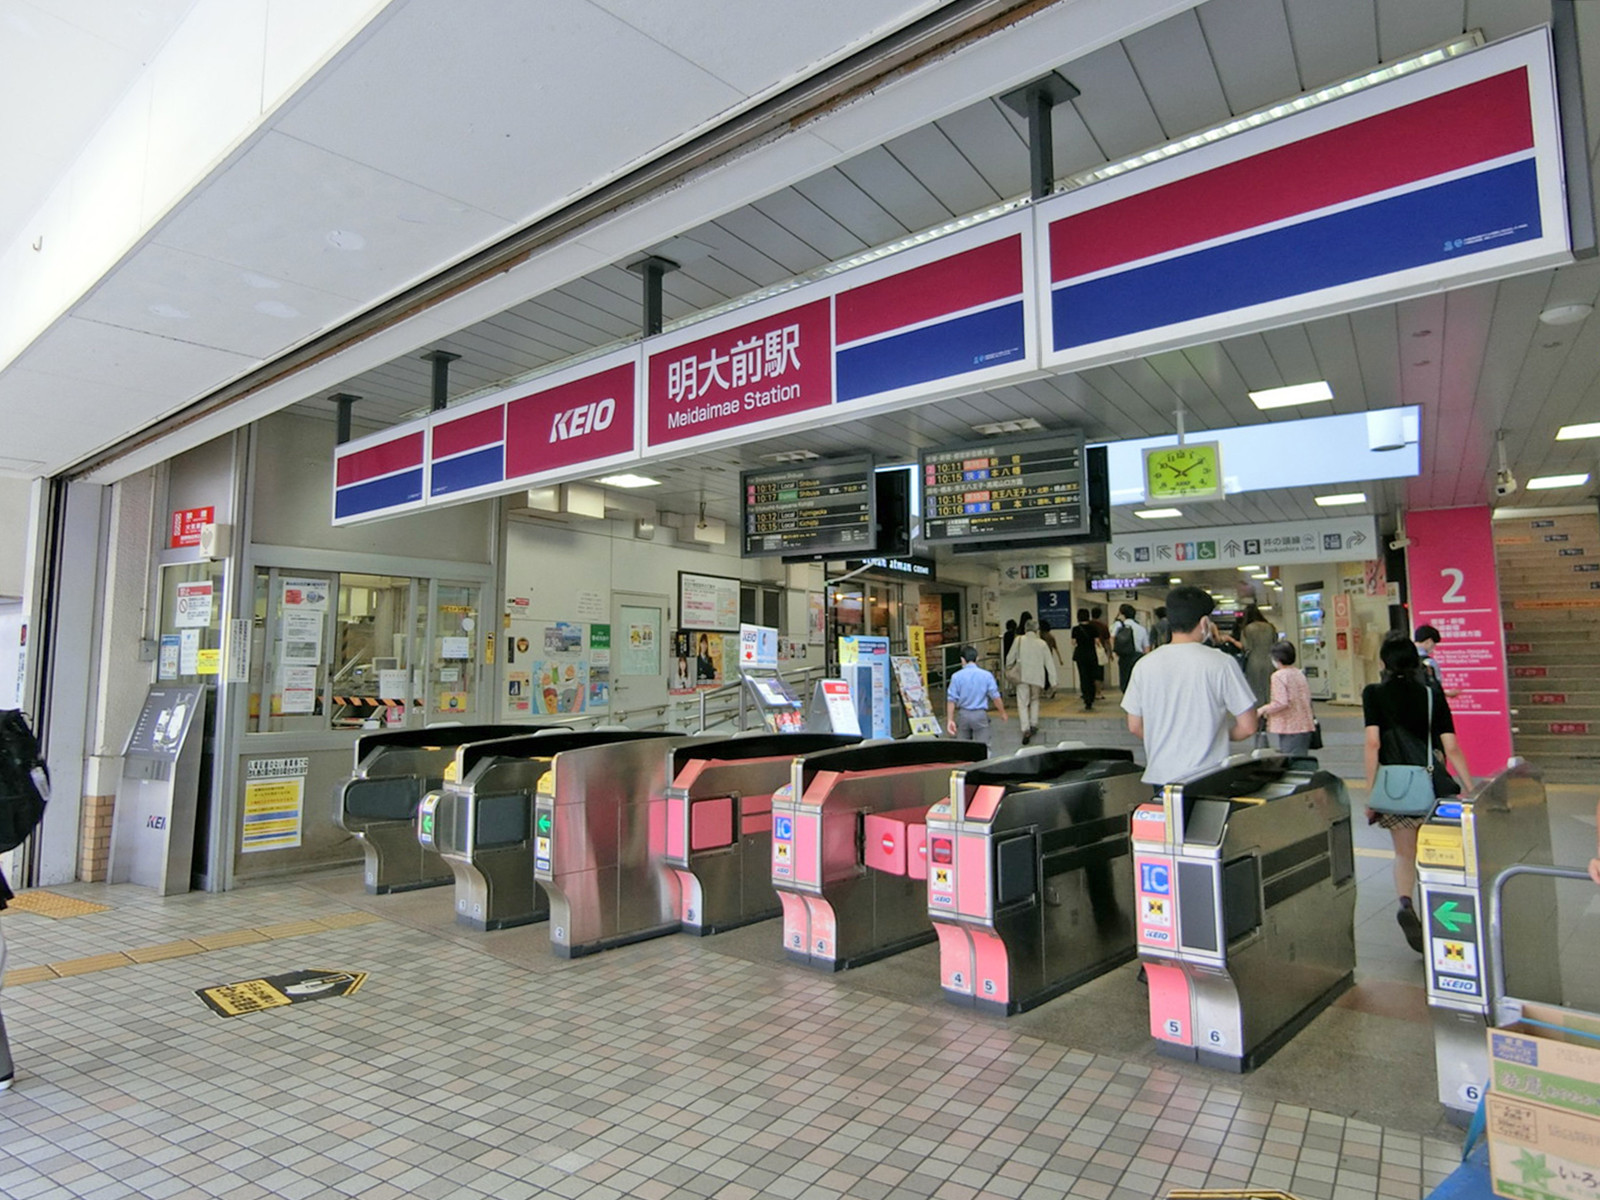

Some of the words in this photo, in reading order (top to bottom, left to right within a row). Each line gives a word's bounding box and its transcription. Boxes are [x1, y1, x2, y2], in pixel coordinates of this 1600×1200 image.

[668, 324, 801, 403] 明大前駅
[668, 401, 740, 429] Meidaimae
[743, 383, 801, 411] Station
[549, 398, 616, 443] KEIO
[937, 462, 961, 473] 10:11
[937, 473, 962, 484] 10:15
[757, 483, 777, 494] 10:12
[938, 494, 963, 505] 10:15
[938, 505, 963, 516] 10:16
[757, 512, 777, 522] 10:12
[1440, 568, 1466, 603] 2
[1049, 593, 1058, 607] 3
[146, 815, 166, 830] KEI
[777, 817, 791, 839] IC
[1142, 865, 1169, 892] IC
[794, 935, 801, 944] 3
[1146, 930, 1169, 940] KEIO
[817, 941, 824, 950] 4
[954, 973, 962, 983] 4
[1441, 978, 1473, 990] KEIO
[985, 980, 993, 990] 5
[1169, 1020, 1179, 1033] 5
[1210, 1030, 1220, 1042] 6
[1466, 1086, 1478, 1100] 6
[1559, 1165, 1600, 1188] いろ
